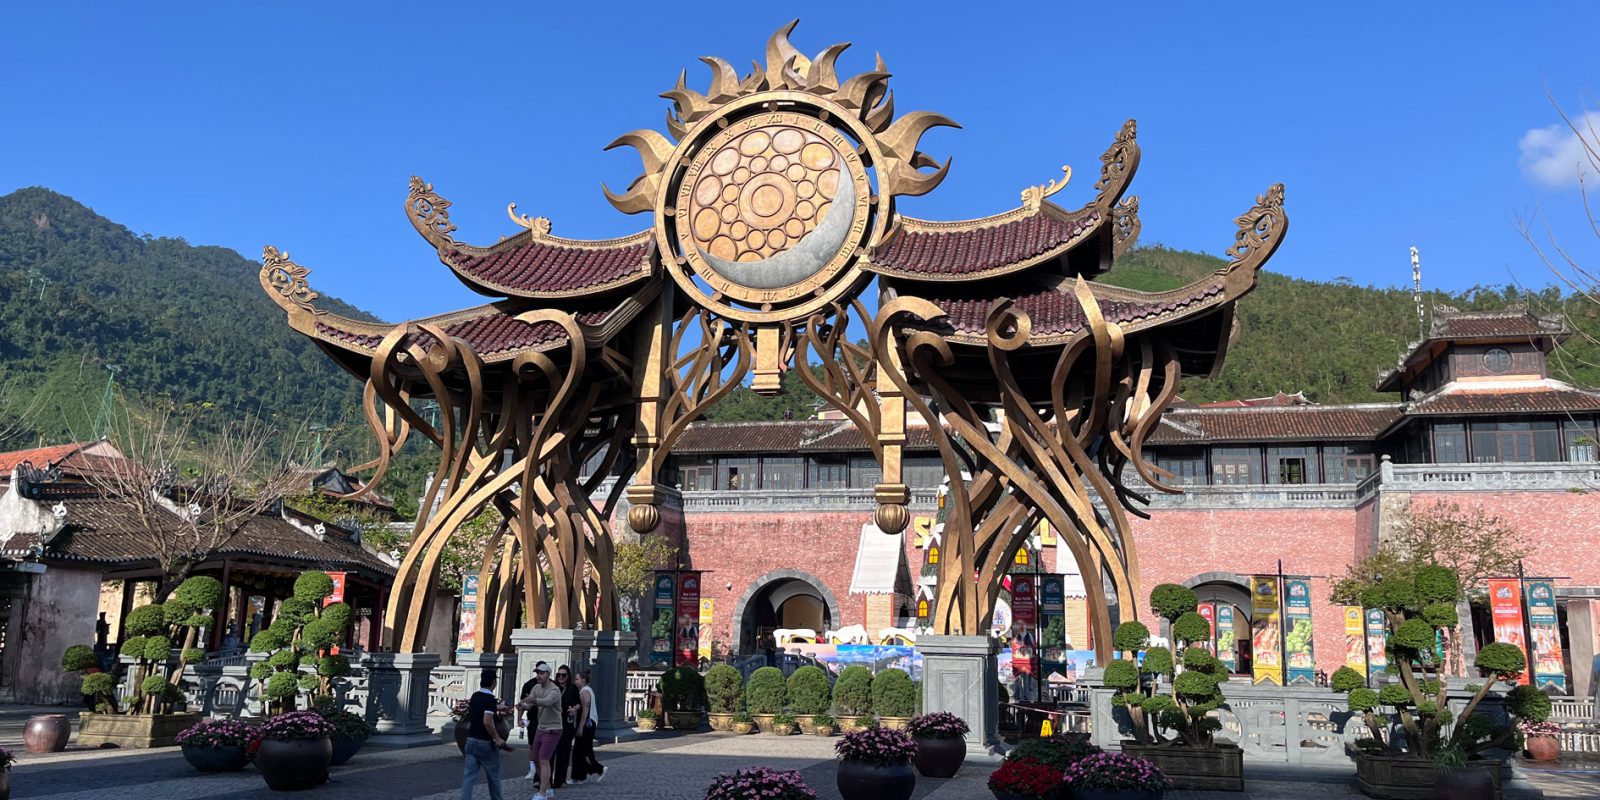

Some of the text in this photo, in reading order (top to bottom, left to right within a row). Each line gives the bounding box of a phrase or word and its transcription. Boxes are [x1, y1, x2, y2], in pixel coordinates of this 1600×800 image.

[744, 120, 757, 129] XI
[767, 115, 782, 124] XII
[814, 122, 823, 132] II
[724, 131, 734, 140] X
[832, 135, 844, 146] III
[704, 143, 717, 157] IX
[846, 153, 858, 163] IV
[688, 159, 704, 177] VIII
[681, 183, 692, 198] VII
[859, 195, 868, 208] VI
[678, 208, 688, 219] VI
[853, 218, 865, 234] VII
[680, 233, 689, 241] V
[840, 239, 858, 258] VIII
[688, 252, 699, 263] IV
[826, 263, 840, 275] IX
[701, 269, 713, 280] III
[809, 278, 821, 287] X
[720, 284, 730, 293] II
[787, 287, 800, 297] XI
[743, 291, 748, 299] I
[761, 292, 779, 301] XII
